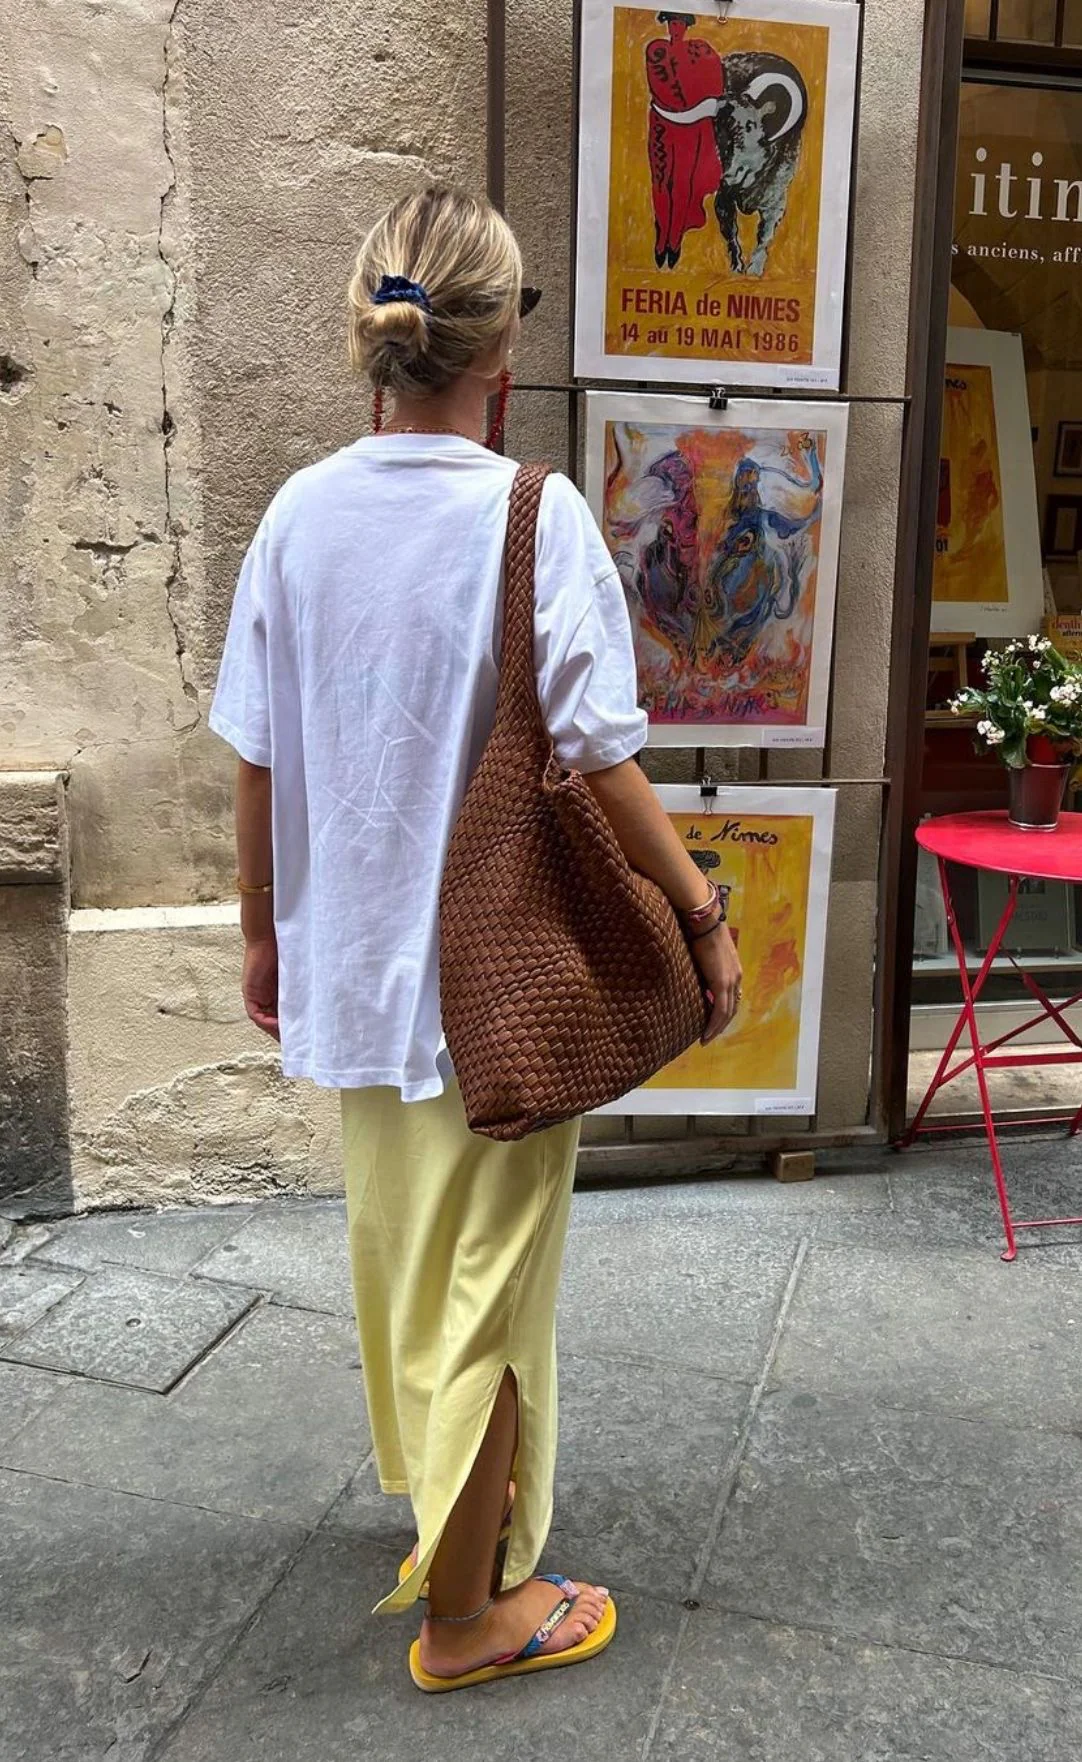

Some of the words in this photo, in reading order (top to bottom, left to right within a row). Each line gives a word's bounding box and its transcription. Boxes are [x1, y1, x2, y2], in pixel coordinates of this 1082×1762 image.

[967, 242, 1045, 264] anciens,
[621, 287, 688, 316] FERIA
[696, 293, 721, 317] de
[727, 294, 801, 323] NIMES
[620, 323, 639, 342] 14
[647, 327, 668, 344] au
[677, 326, 695, 346] 19
[701, 328, 741, 349] MAI
[753, 332, 799, 352] 1986
[936, 538, 949, 552] 01
[686, 825, 703, 840] de
